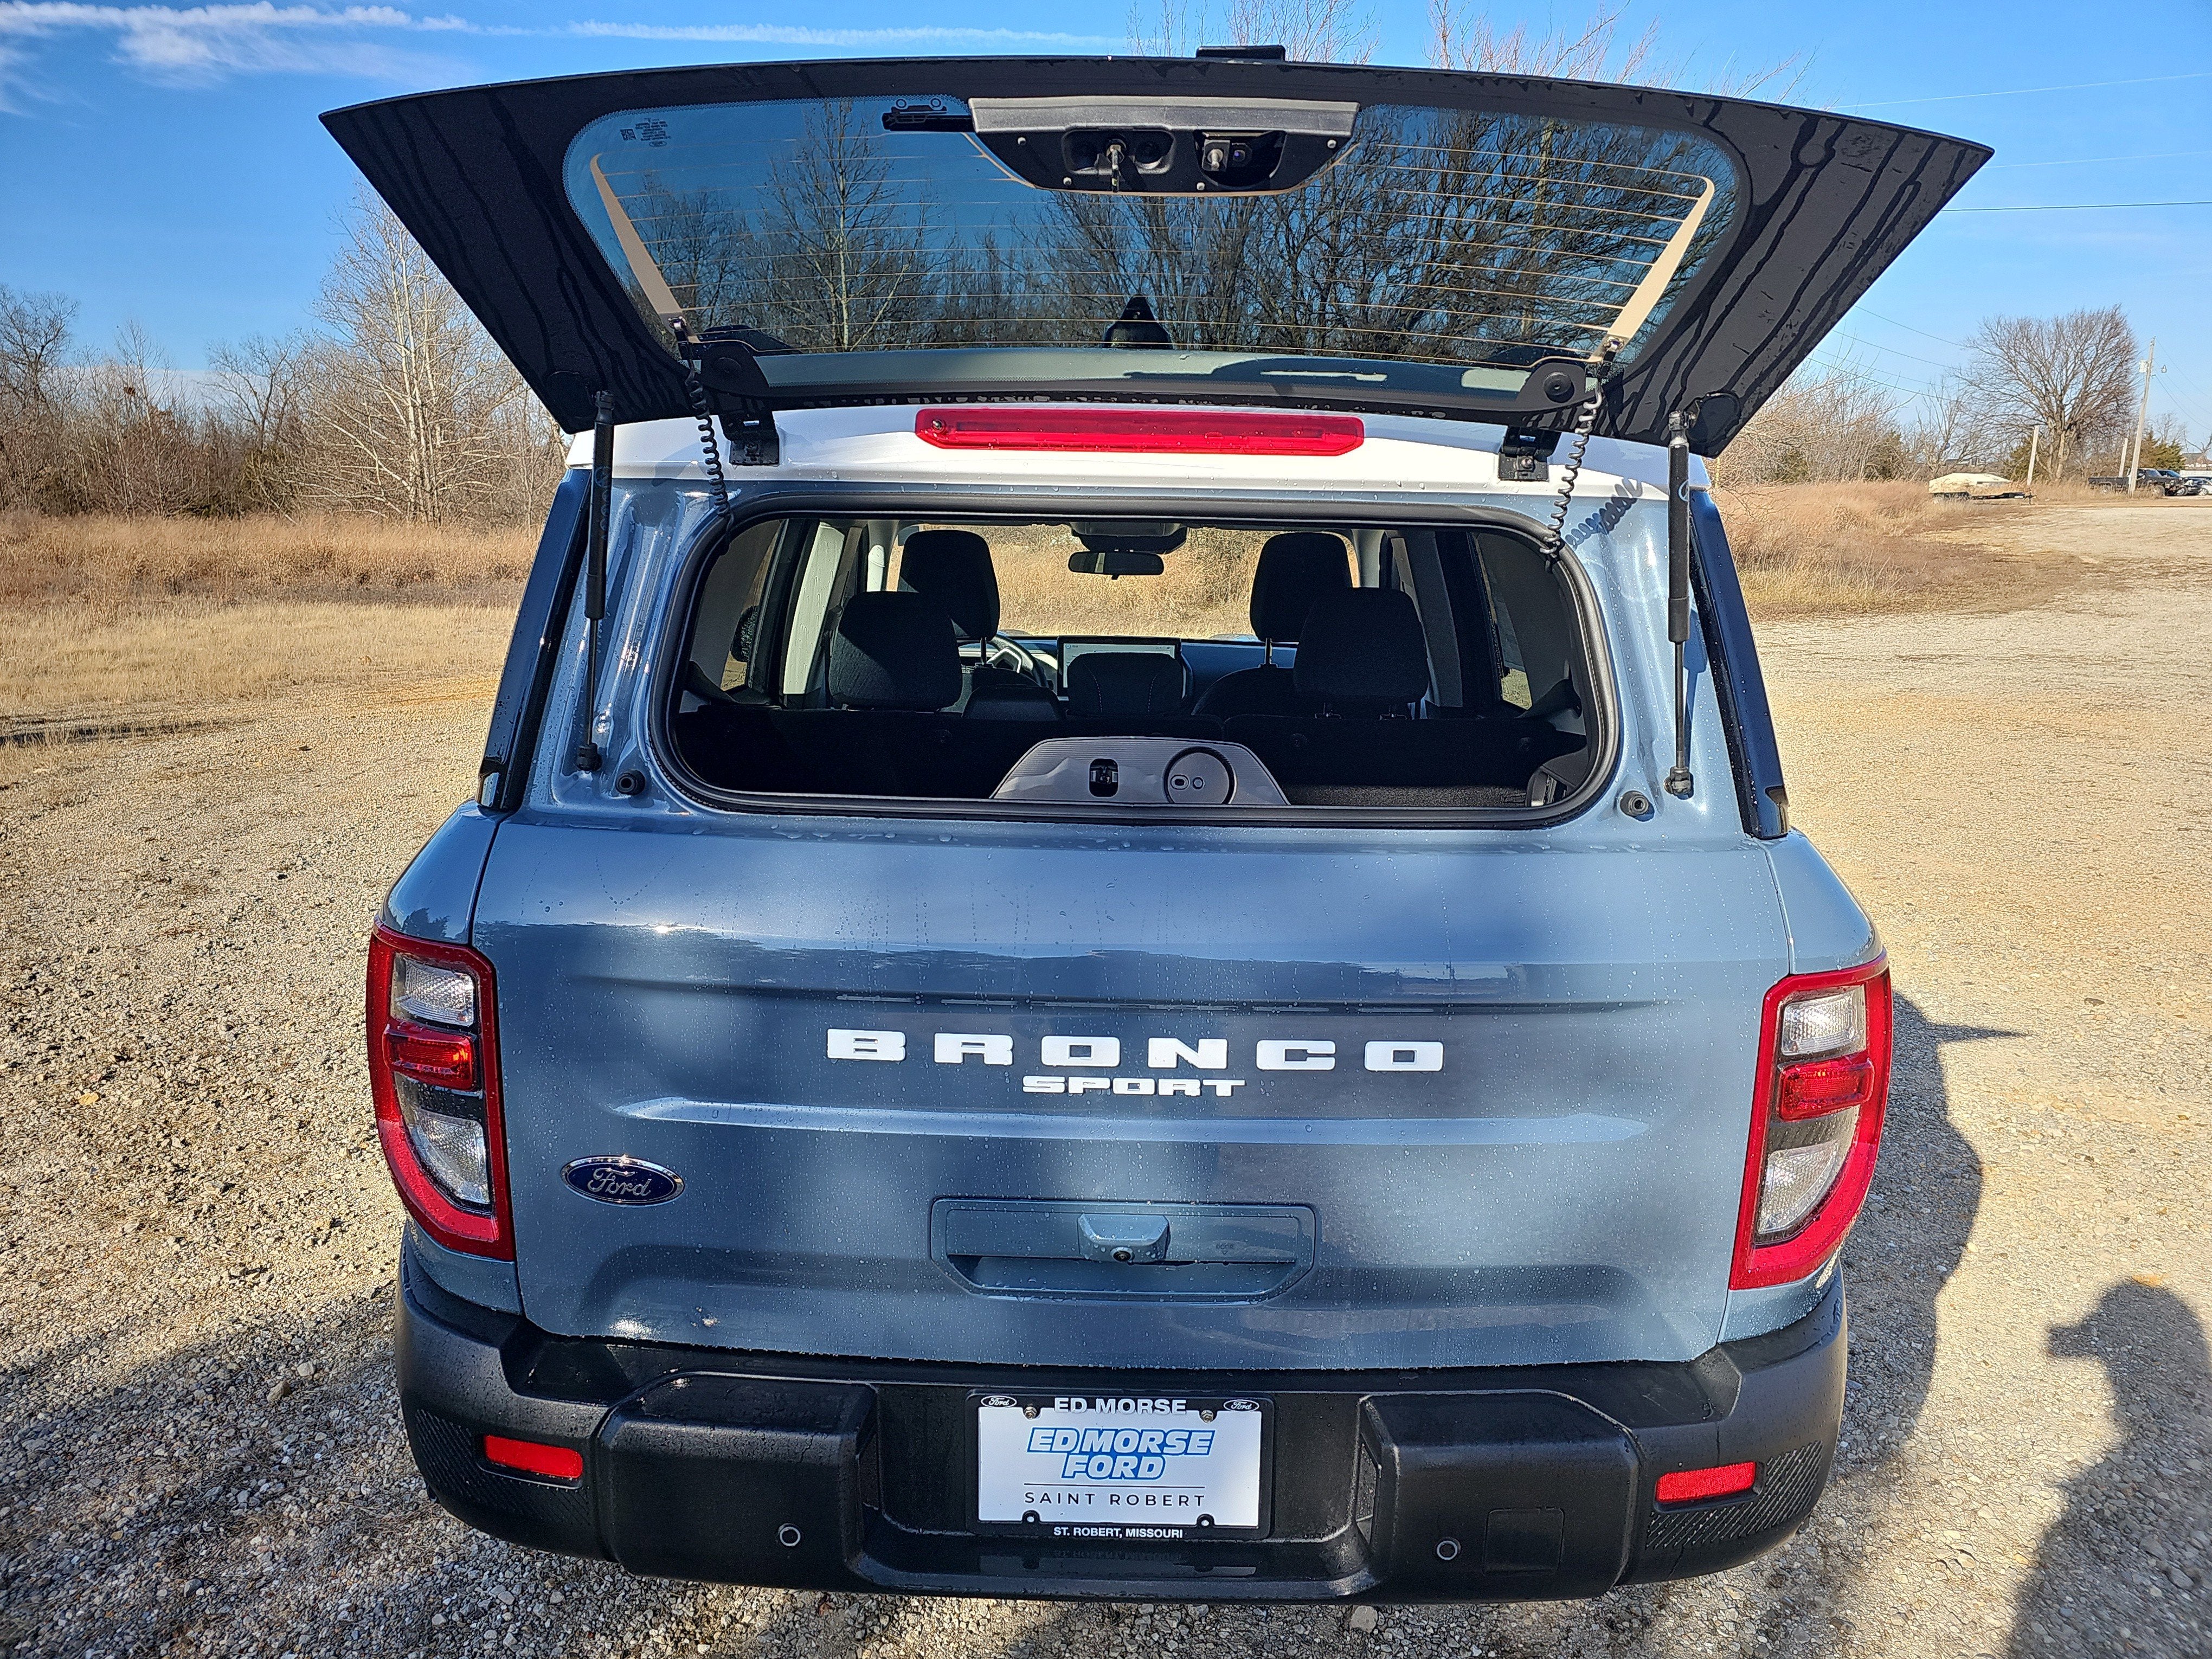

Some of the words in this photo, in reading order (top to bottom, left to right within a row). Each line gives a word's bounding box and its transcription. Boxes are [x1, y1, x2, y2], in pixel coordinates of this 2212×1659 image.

[827, 1028, 1444, 1072] BRONCO
[1023, 1076, 1245, 1096] SPORT
[587, 1167, 652, 1196] Ford
[988, 1397, 1009, 1406] Ford
[1054, 1397, 1087, 1413] ED
[1096, 1398, 1187, 1416] MORSE
[1231, 1401, 1252, 1410] Ford
[1026, 1427, 1080, 1453] ED
[1079, 1428, 1216, 1455] MORSE
[1061, 1455, 1167, 1480] FORD
[1025, 1492, 1095, 1505] SAINT
[1110, 1494, 1205, 1507] ROBERT
[1053, 1527, 1070, 1536] ST.
[1073, 1527, 1122, 1539] ROBERT,
[1126, 1528, 1183, 1539] MISSOURI
